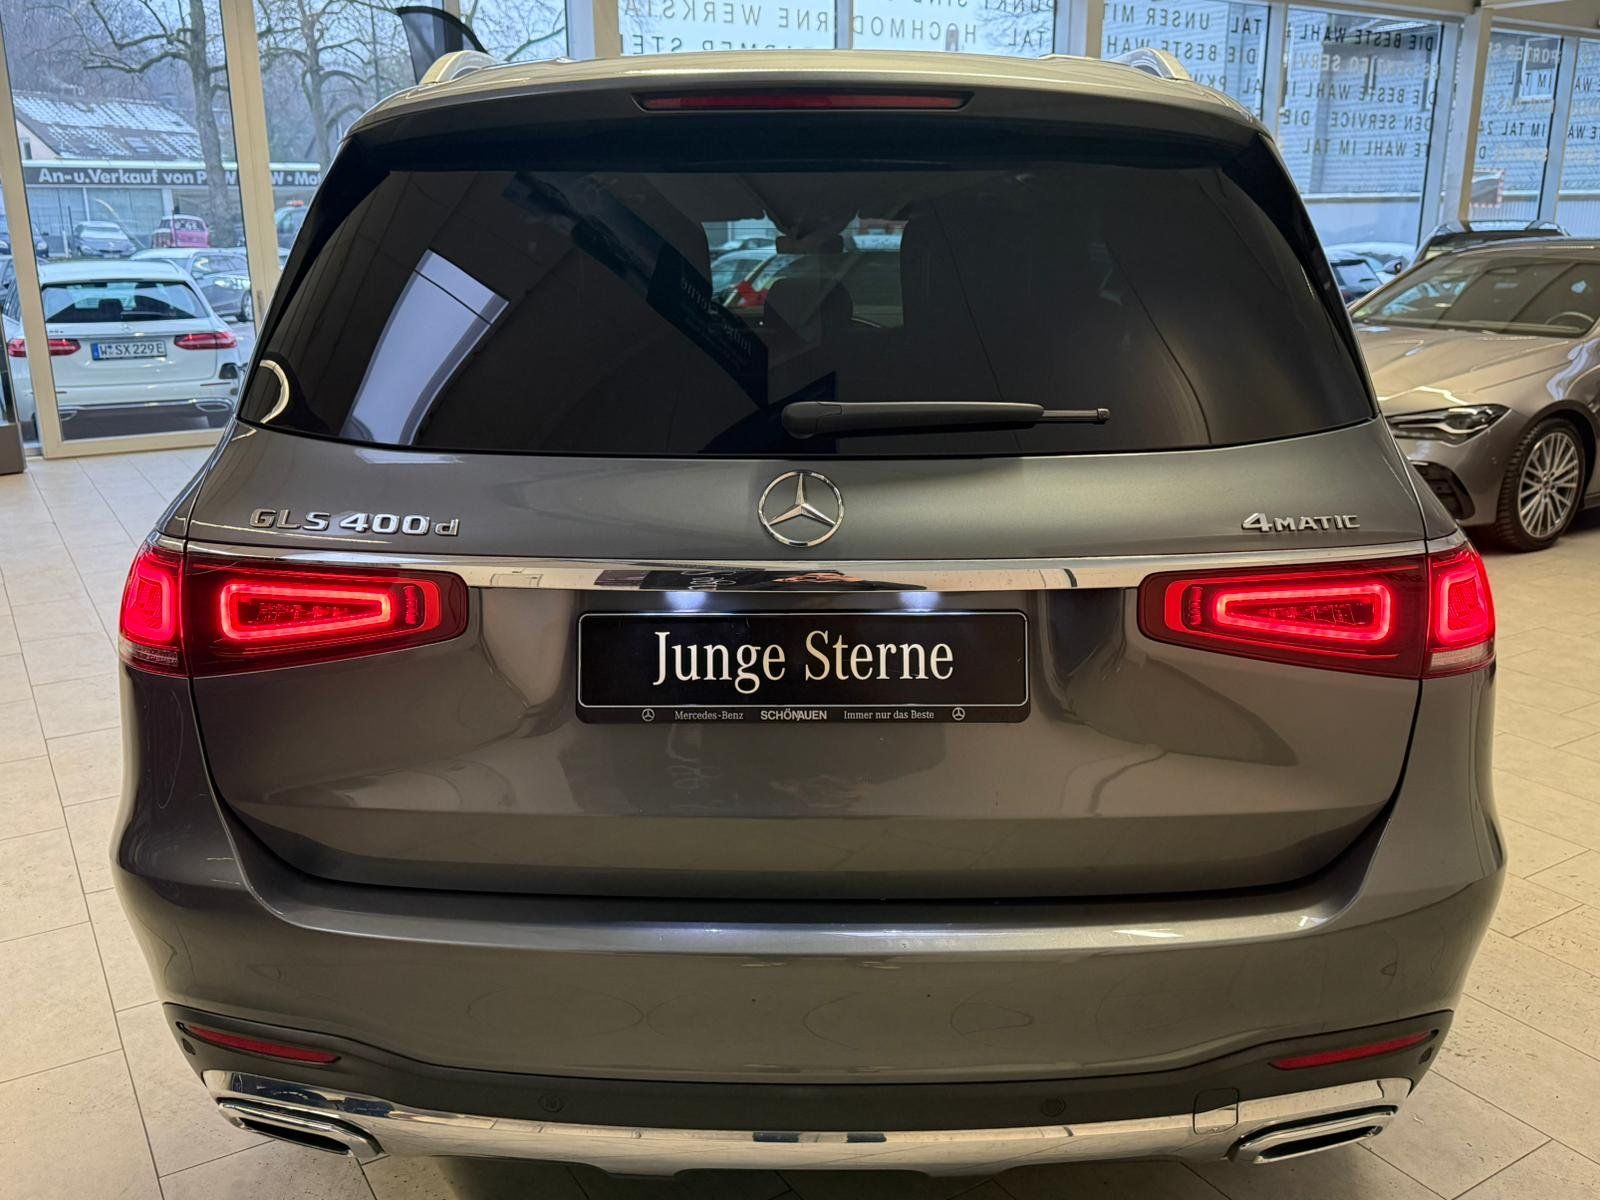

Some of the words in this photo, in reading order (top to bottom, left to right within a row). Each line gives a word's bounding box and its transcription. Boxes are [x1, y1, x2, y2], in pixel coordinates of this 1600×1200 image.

[163, 173, 195, 184] von
[196, 171, 237, 185] PW
[250, 508, 331, 532] GLS
[1242, 512, 1361, 532] 4MATIC
[652, 630, 786, 695] Junge
[806, 629, 954, 681] Sterne
[674, 710, 744, 721] Mercedes-Benz
[844, 710, 873, 720] Immer
[875, 712, 892, 720] nur
[893, 710, 908, 720] das
[911, 710, 935, 720] Beste
